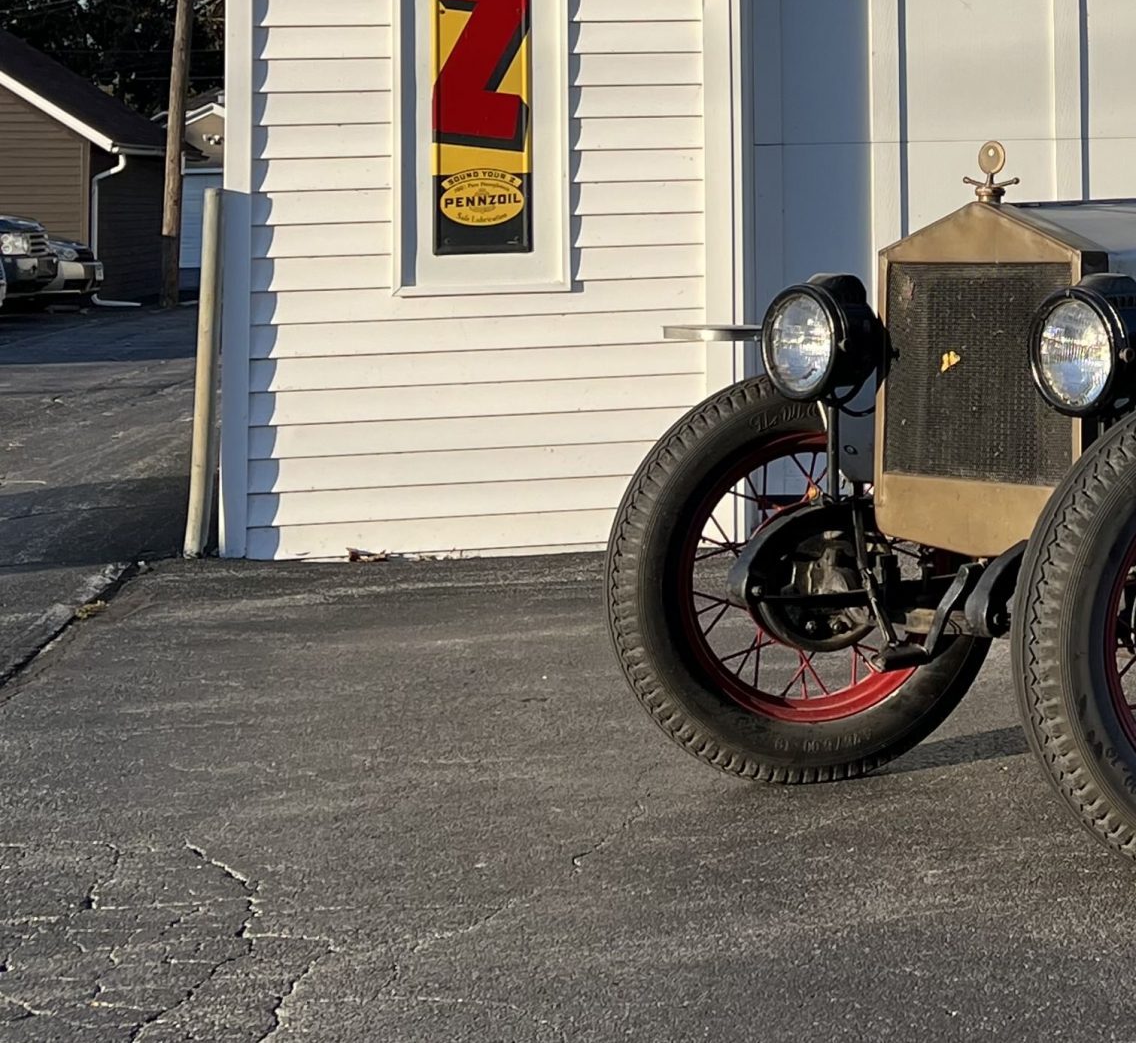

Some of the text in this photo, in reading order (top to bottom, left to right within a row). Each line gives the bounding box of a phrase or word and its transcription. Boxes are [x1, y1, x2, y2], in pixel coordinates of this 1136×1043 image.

[447, 170, 516, 186] SOUND YOUR Z
[444, 193, 522, 208] PENNZOIL
